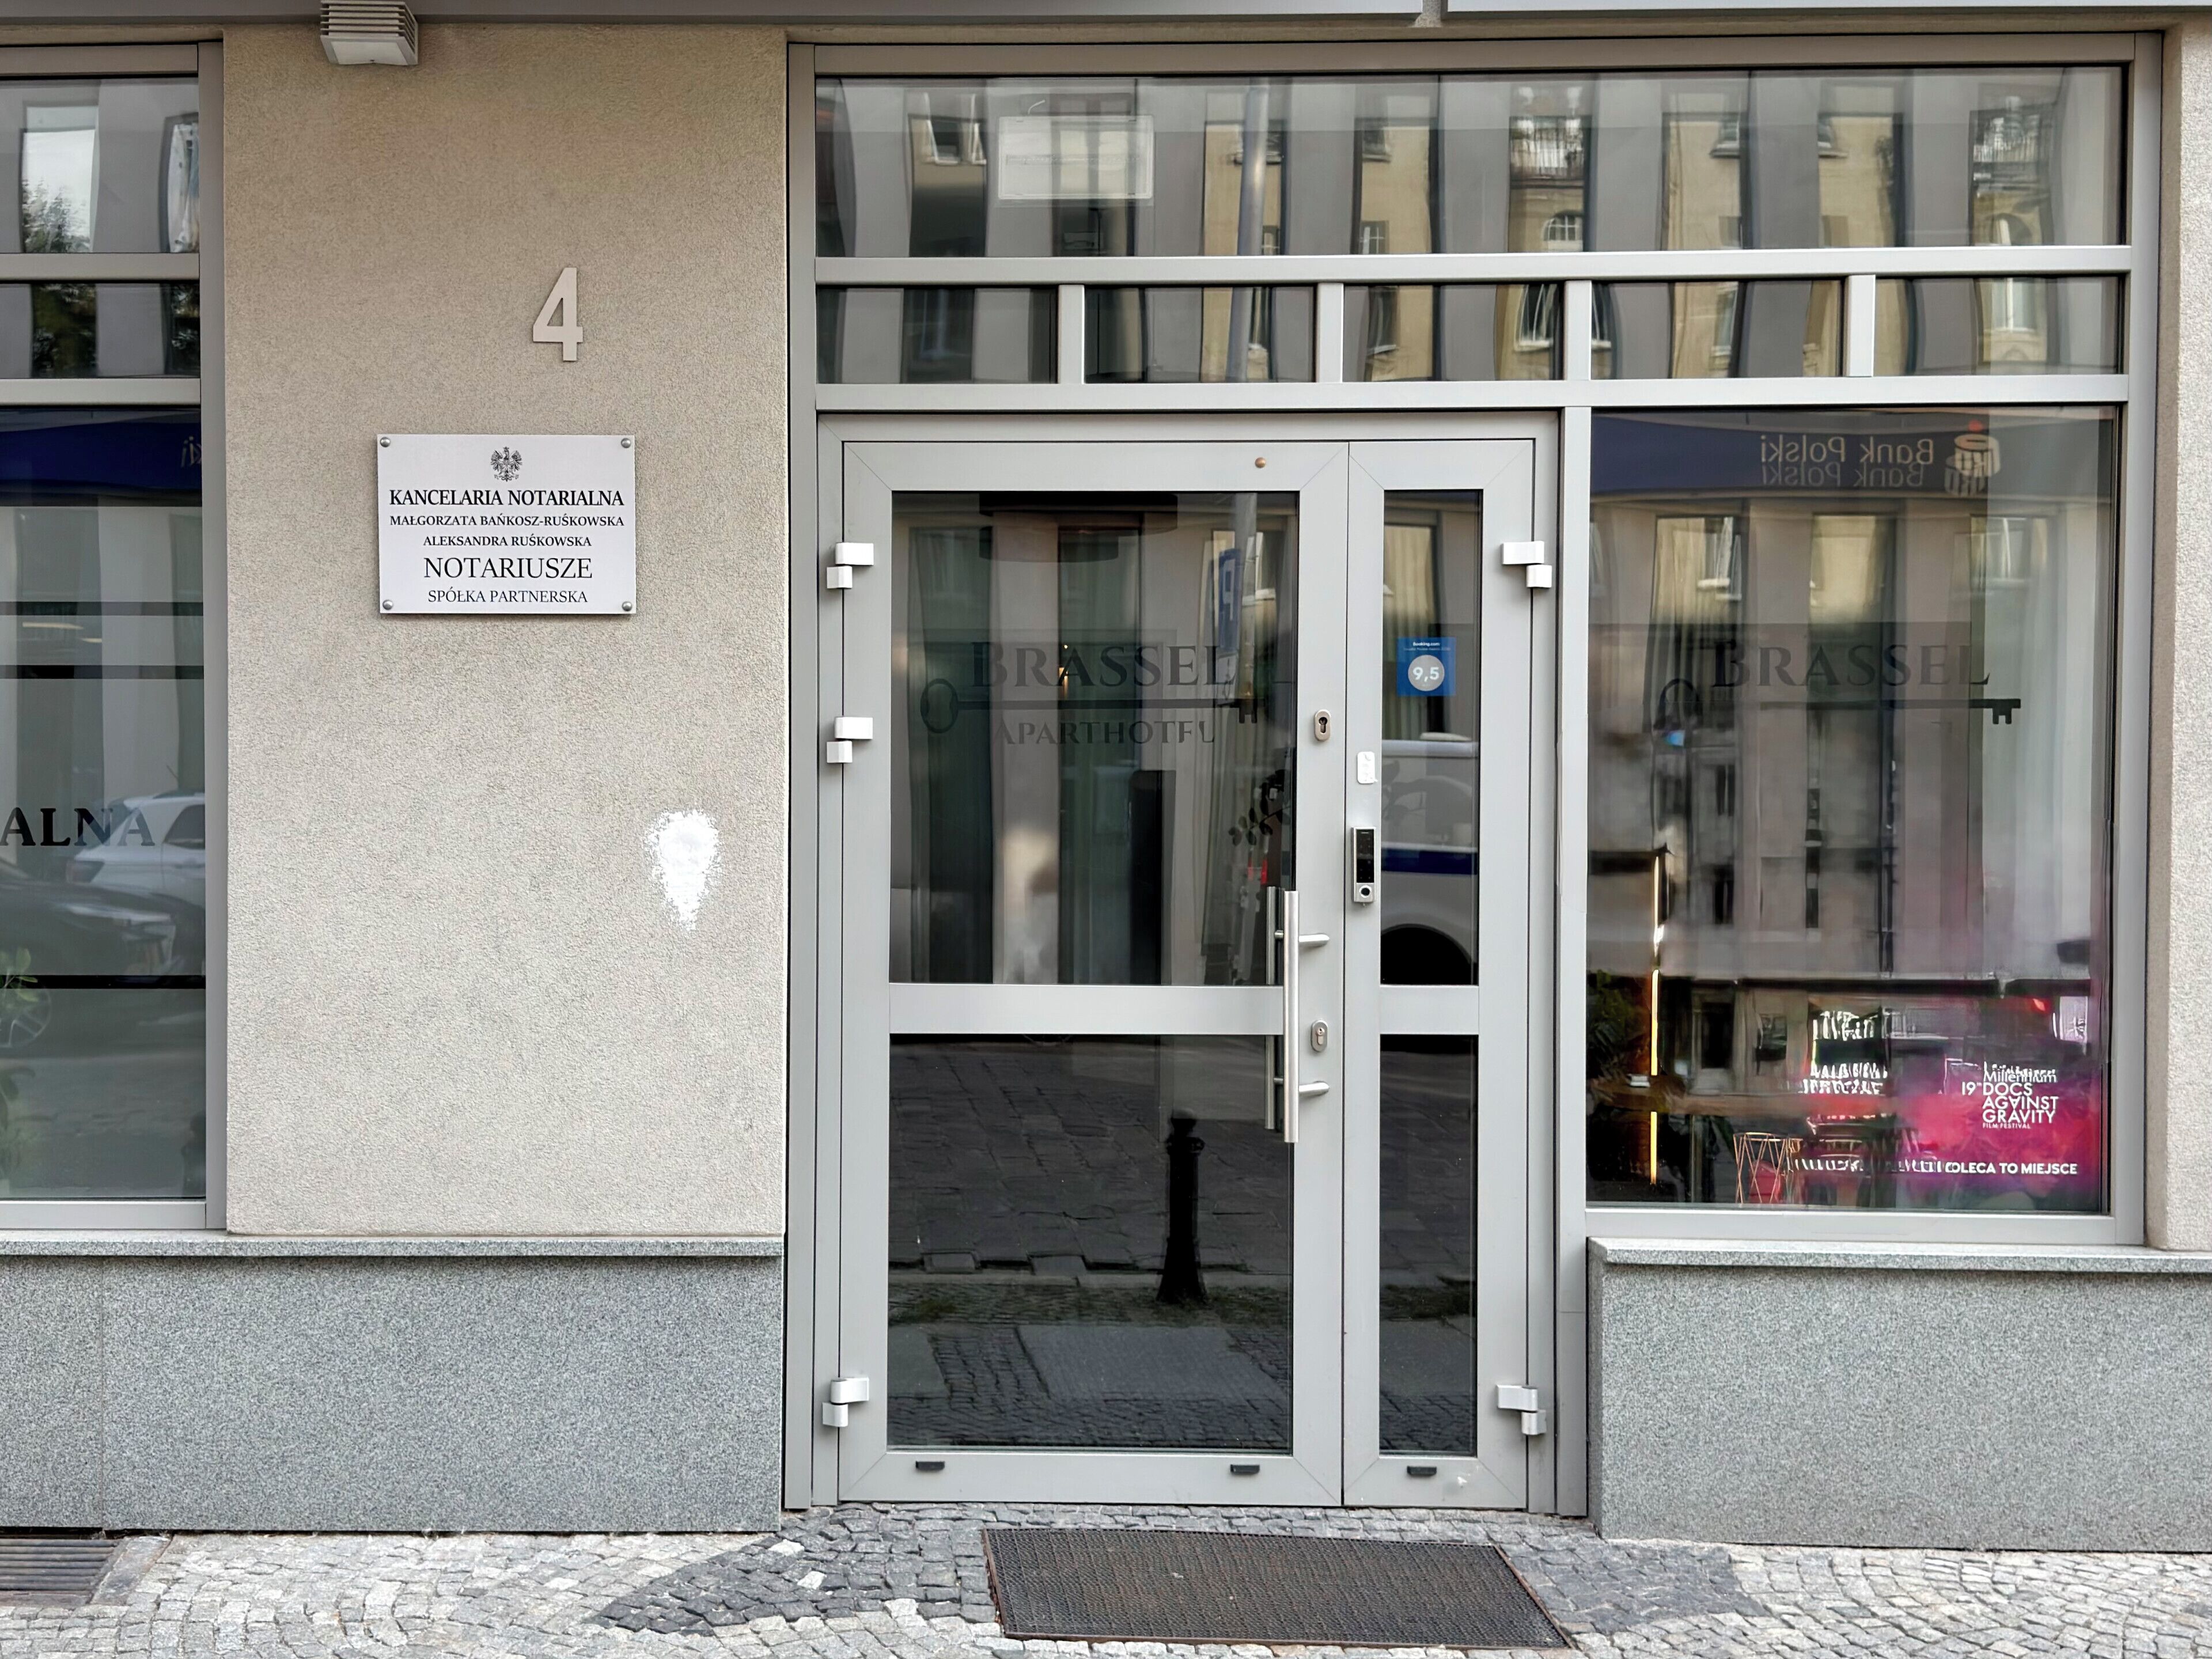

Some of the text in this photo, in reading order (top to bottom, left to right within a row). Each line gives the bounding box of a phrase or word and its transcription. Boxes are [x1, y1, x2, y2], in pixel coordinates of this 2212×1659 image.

[533, 267, 583, 362] 4
[389, 490, 624, 506] KANCELARIA NOTARIALNA
[390, 513, 624, 527] MAŁGORZATA BAŃKOSZ-RUŚKOWSKA
[423, 533, 592, 547] ALEKSANDRA RUŚKOWSKA
[424, 558, 592, 578] NOTARIUSZE
[428, 586, 588, 603] SPÓŁKA PARTNERSKA
[971, 642, 1236, 687] BRASSEL
[1712, 640, 1990, 687] BRASSEL
[1412, 666, 1440, 682] 9,5
[1983, 1082, 2033, 1096] DOCS
[1982, 1096, 2059, 1109] AGAINST
[1982, 1109, 2056, 1123] GRAVITY
[1999, 1162, 2018, 1174] TO
[2021, 1163, 2078, 1175] MIEJSCE
